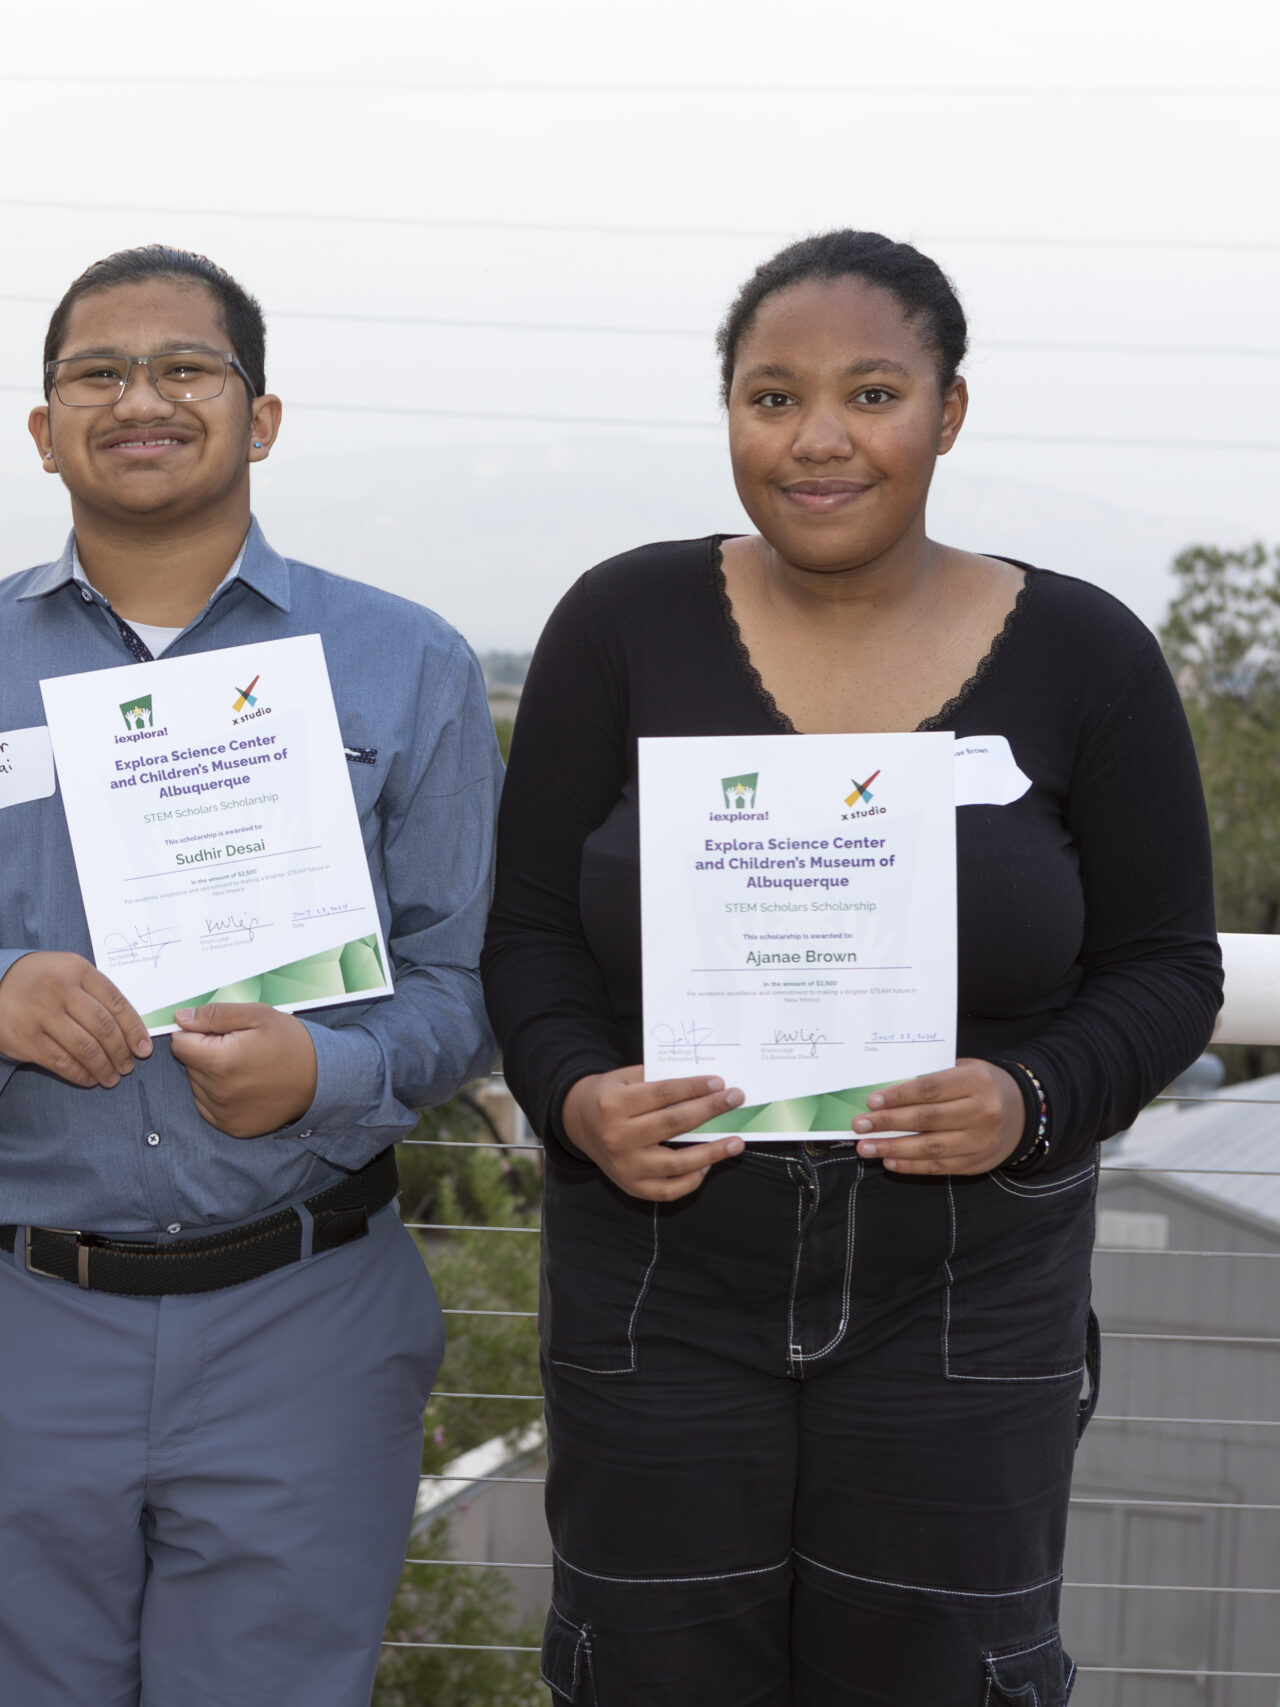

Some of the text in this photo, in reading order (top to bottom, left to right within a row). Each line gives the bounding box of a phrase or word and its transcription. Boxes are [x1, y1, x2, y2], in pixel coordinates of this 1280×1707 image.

[241, 708, 272, 723] studio
[115, 736, 276, 772] Explora Science Center
[110, 748, 288, 790] and Children’s Museum of
[160, 776, 251, 799] Albuquerque
[144, 793, 279, 824] STEM Scholars Scholarship
[851, 807, 887, 819] studio
[180, 832, 218, 844] scholarship
[225, 825, 254, 836] awarded
[176, 839, 266, 865] Sudhir Desai
[705, 837, 886, 855] Explora Science Center
[696, 855, 896, 871] and Children’s Museum of
[747, 876, 850, 891] Albuquerque
[725, 901, 877, 913] STEM Scholars Scholarship
[746, 950, 857, 967] Ajanae Brown
